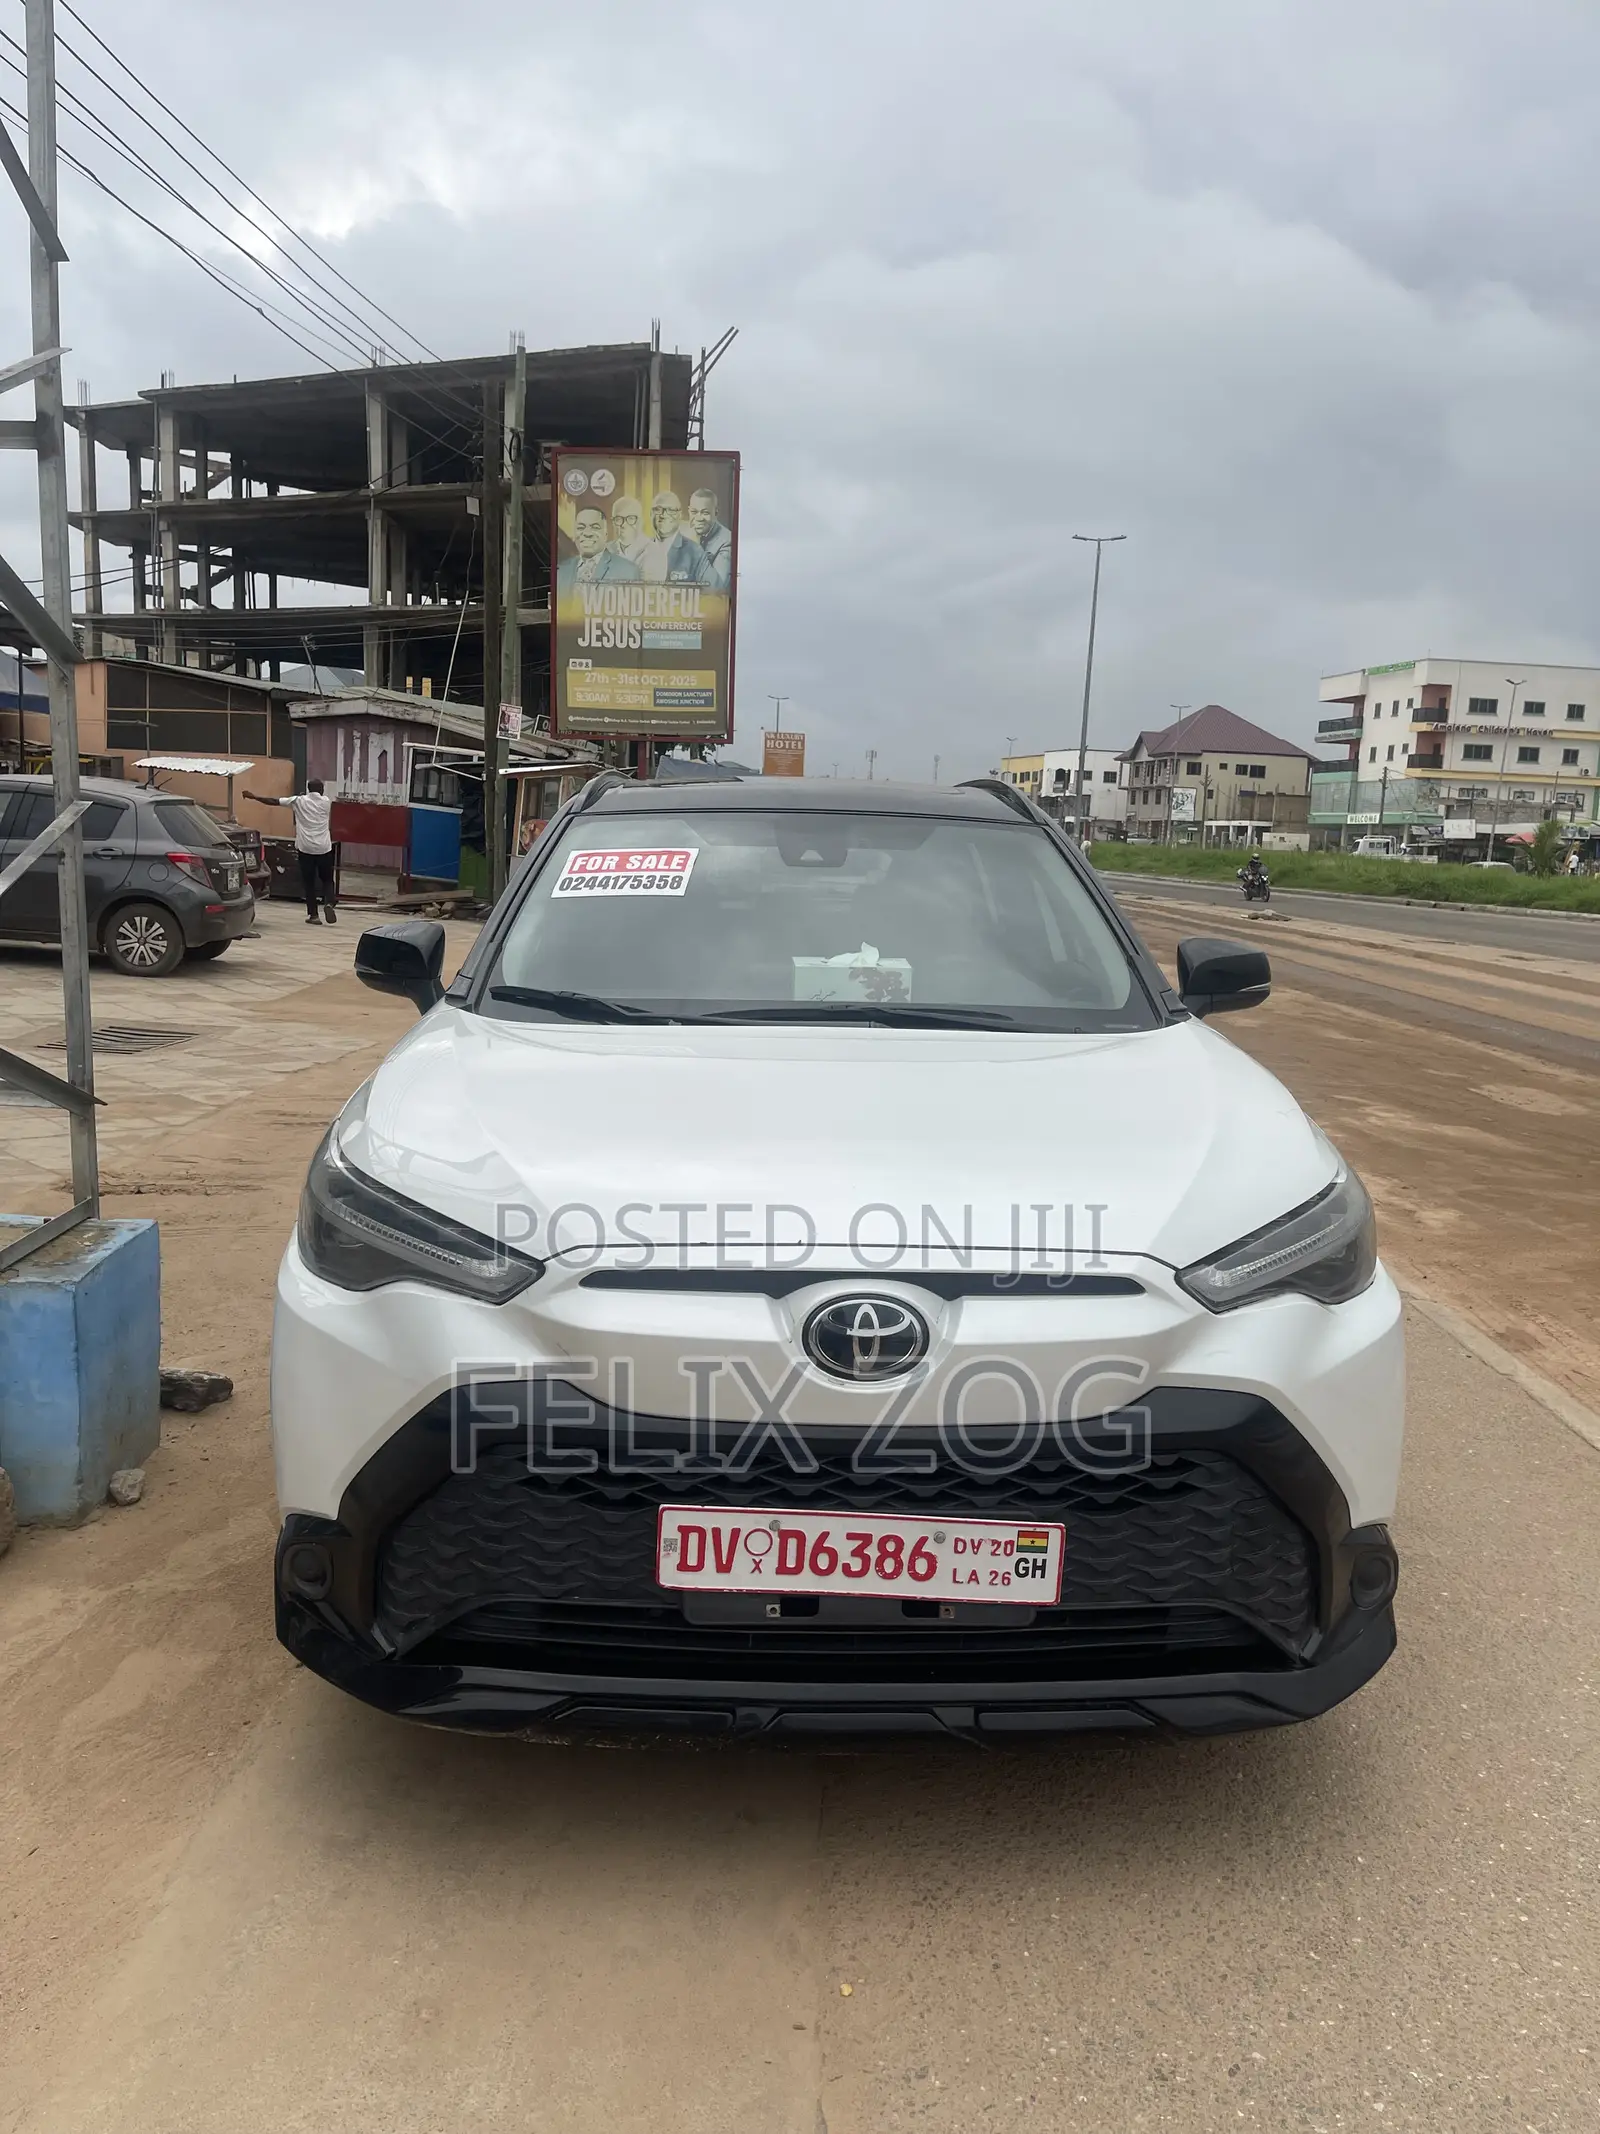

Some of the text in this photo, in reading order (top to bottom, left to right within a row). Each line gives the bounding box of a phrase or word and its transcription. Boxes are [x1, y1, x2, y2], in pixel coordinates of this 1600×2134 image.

[583, 585, 705, 618] WONDERFUL
[577, 617, 702, 649] JESUS CONFERENCE
[585, 672, 609, 684] 27th
[670, 675, 697, 686] 2025
[1525, 728, 1553, 736] Haven
[766, 740, 803, 749] HOTEL
[1349, 814, 1377, 823] WELCOME
[572, 854, 687, 871] FOR SALE
[558, 875, 684, 891] 0244175358
[677, 1524, 741, 1573] DV
[953, 1537, 1015, 1557] DV 20
[1015, 1557, 1047, 1579] GH
[952, 1568, 1012, 1586] LA 26
